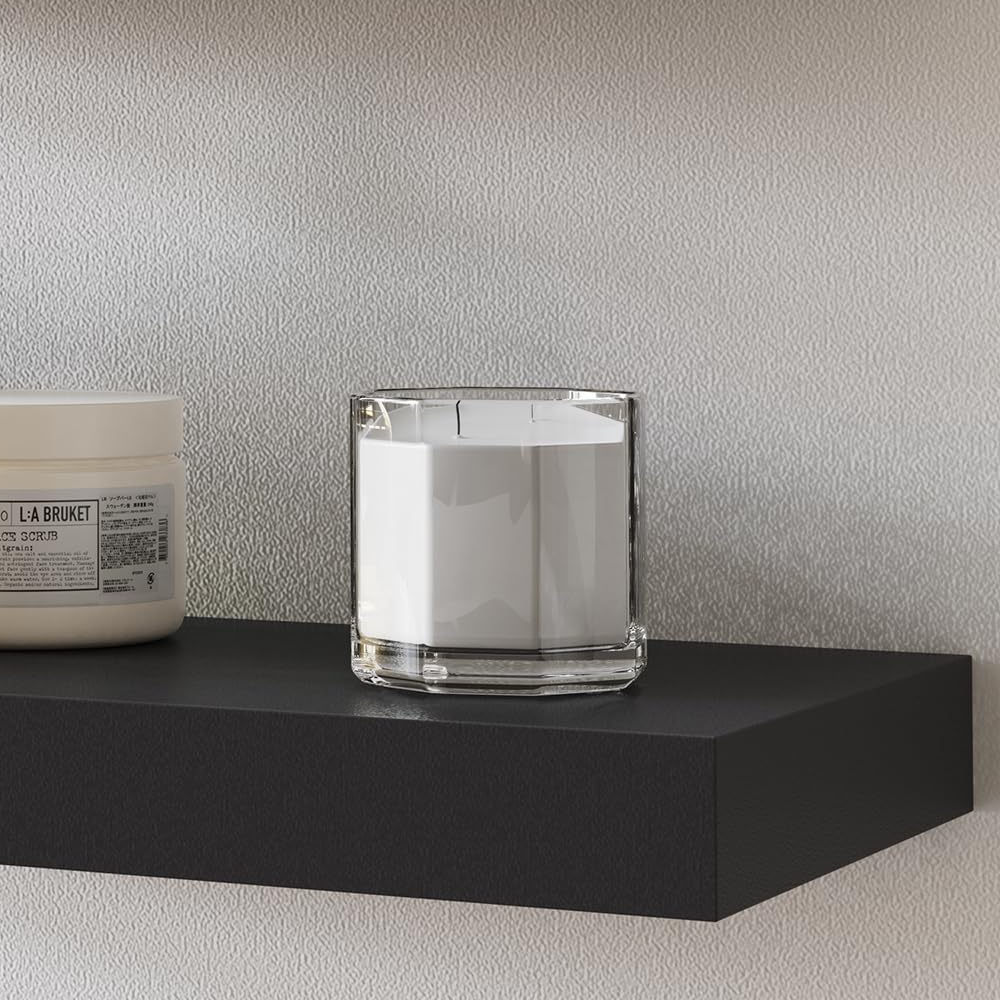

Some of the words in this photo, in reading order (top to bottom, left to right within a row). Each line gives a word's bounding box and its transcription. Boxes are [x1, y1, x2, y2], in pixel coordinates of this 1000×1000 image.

[20, 506, 40, 522] L:A
[44, 506, 91, 522] BRUKET
[20, 531, 58, 542] SCRUB
